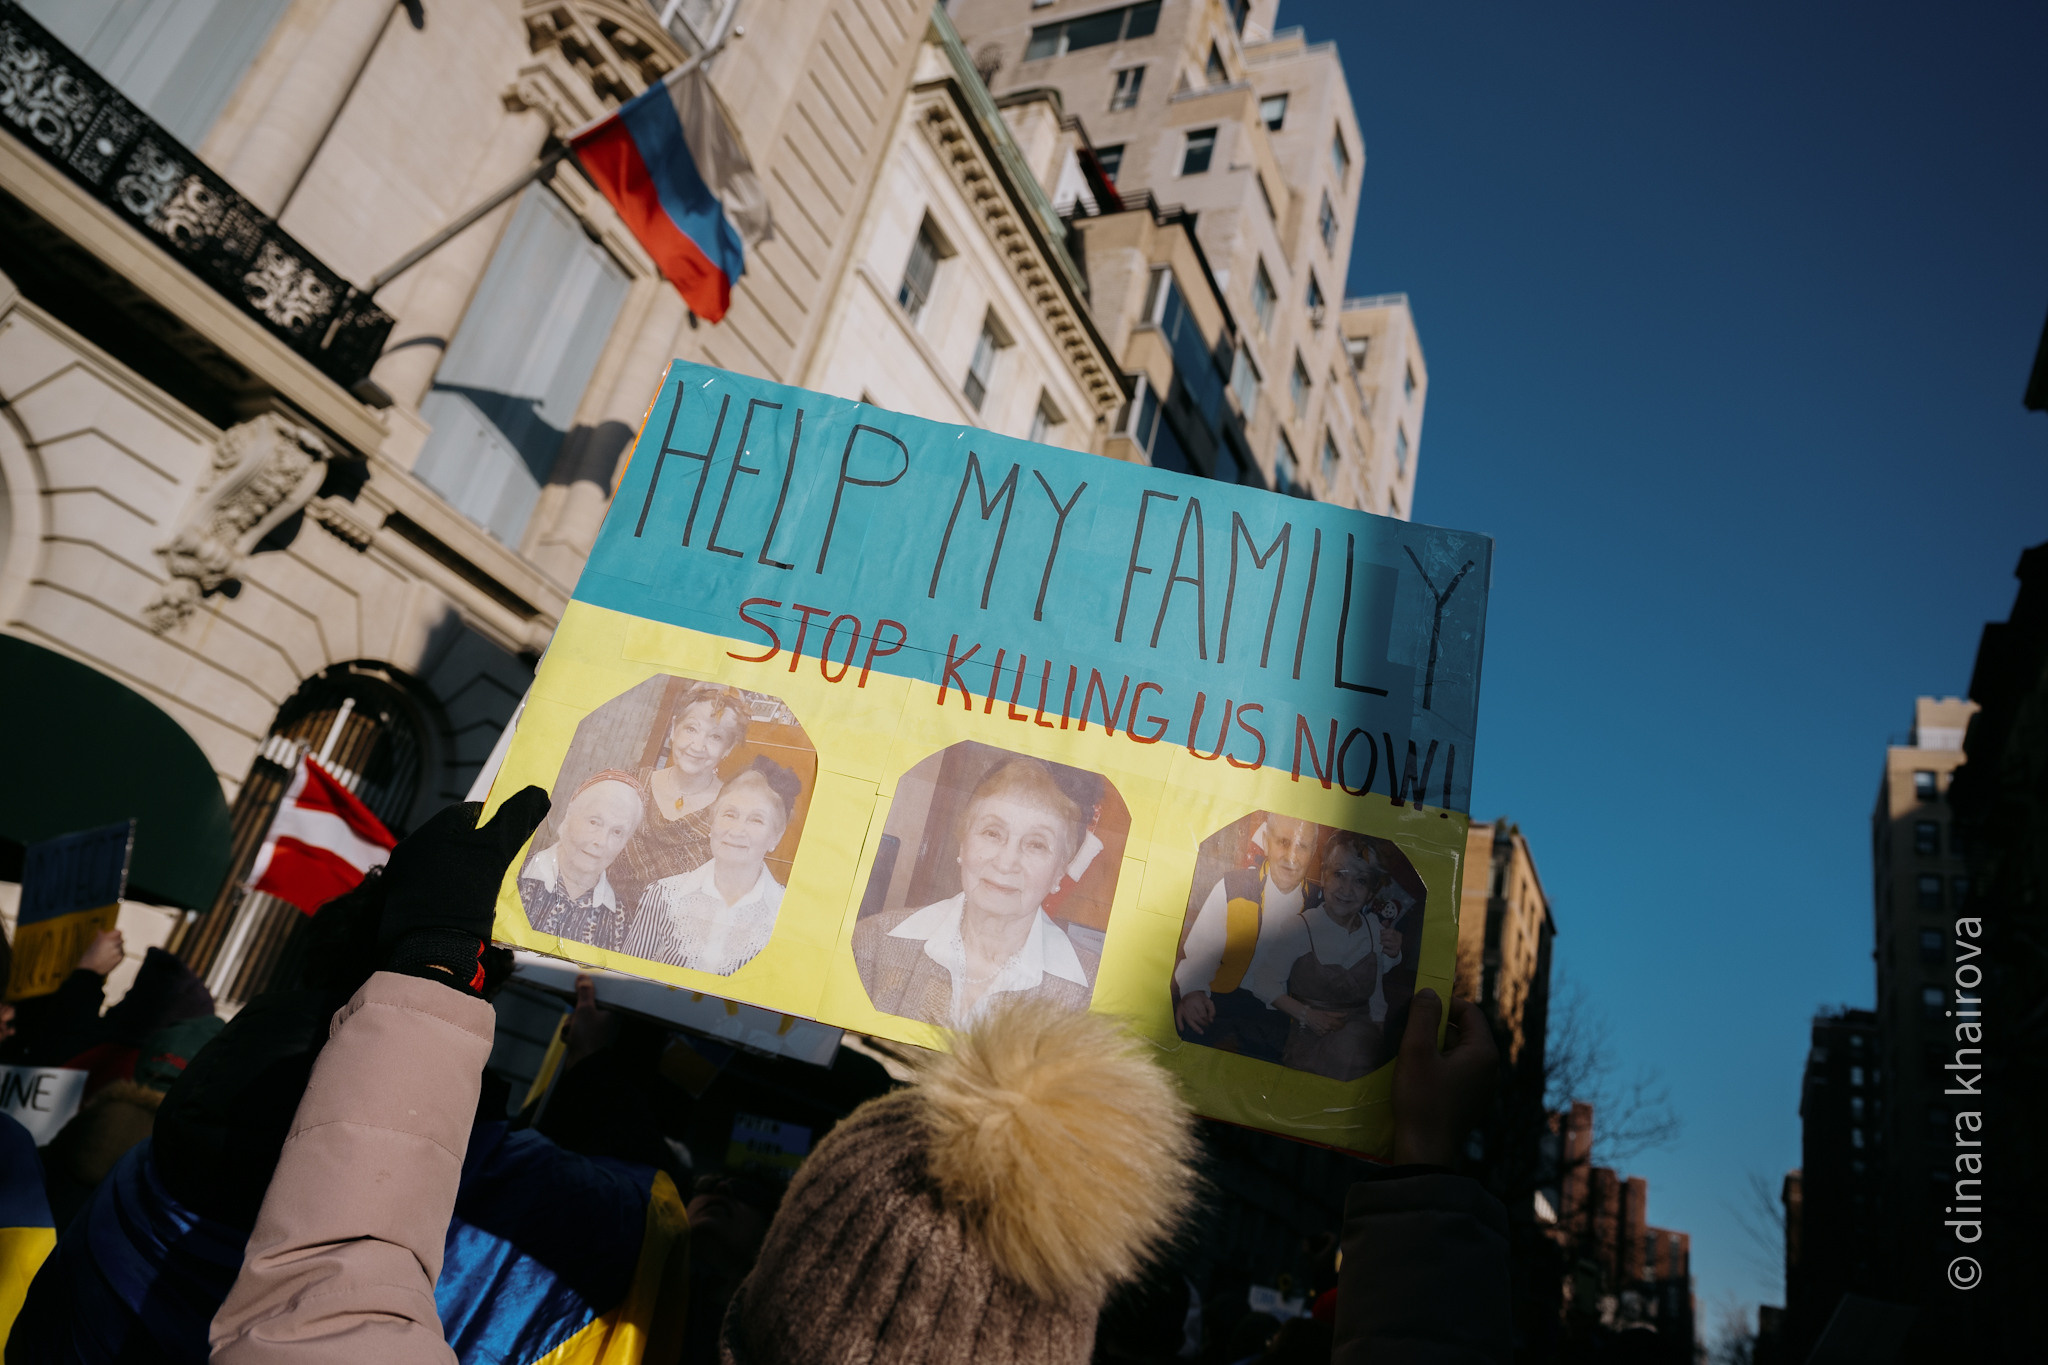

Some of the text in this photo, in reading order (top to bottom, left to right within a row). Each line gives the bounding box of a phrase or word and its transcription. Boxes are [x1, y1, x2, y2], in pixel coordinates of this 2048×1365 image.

[634, 380, 1475, 711] HELP MY FAMILY
[726, 597, 1456, 819] STOP KILLING US NOW!
